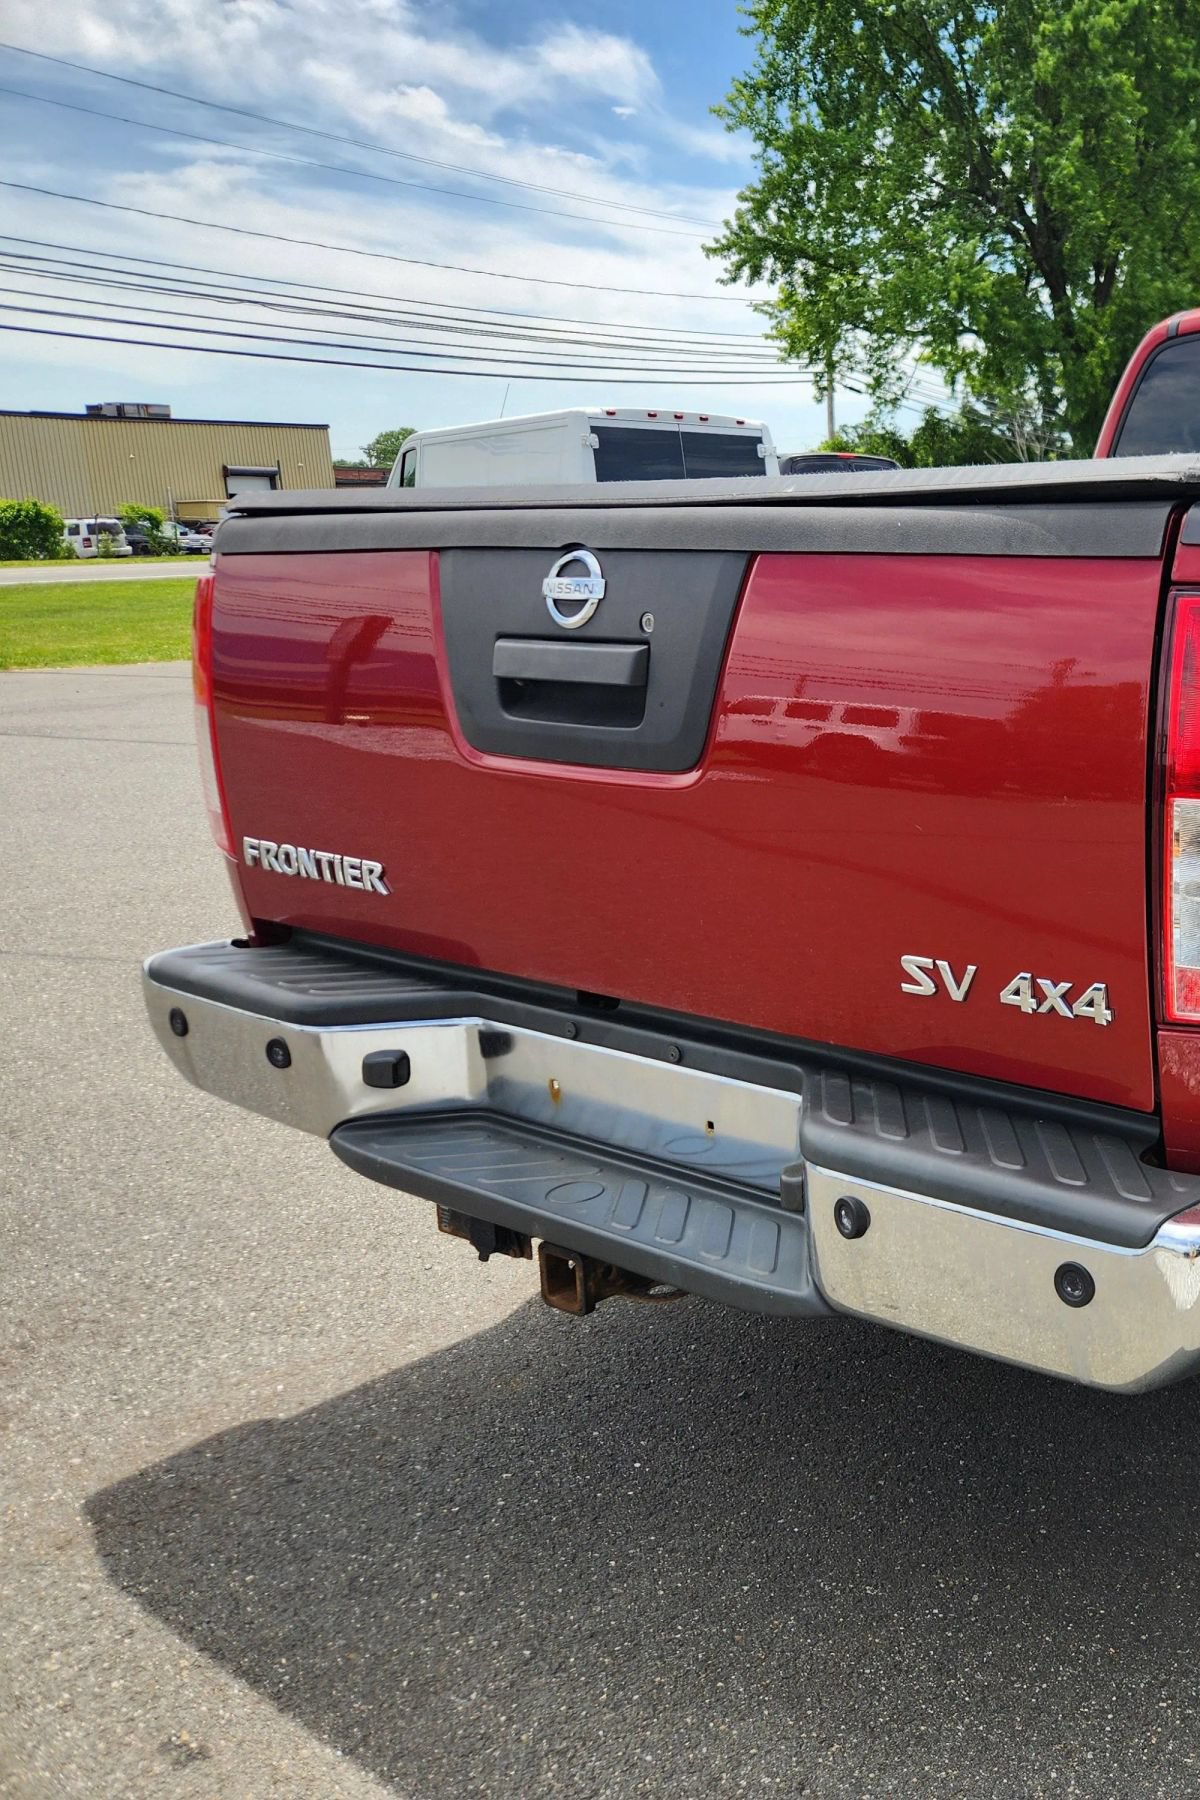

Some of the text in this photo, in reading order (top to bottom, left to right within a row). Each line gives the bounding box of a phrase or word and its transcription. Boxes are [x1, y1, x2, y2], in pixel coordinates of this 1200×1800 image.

[546, 582, 594, 595] NISSAN
[243, 836, 390, 895] FRONTIER
[900, 954, 1113, 1026] SV 4X4
